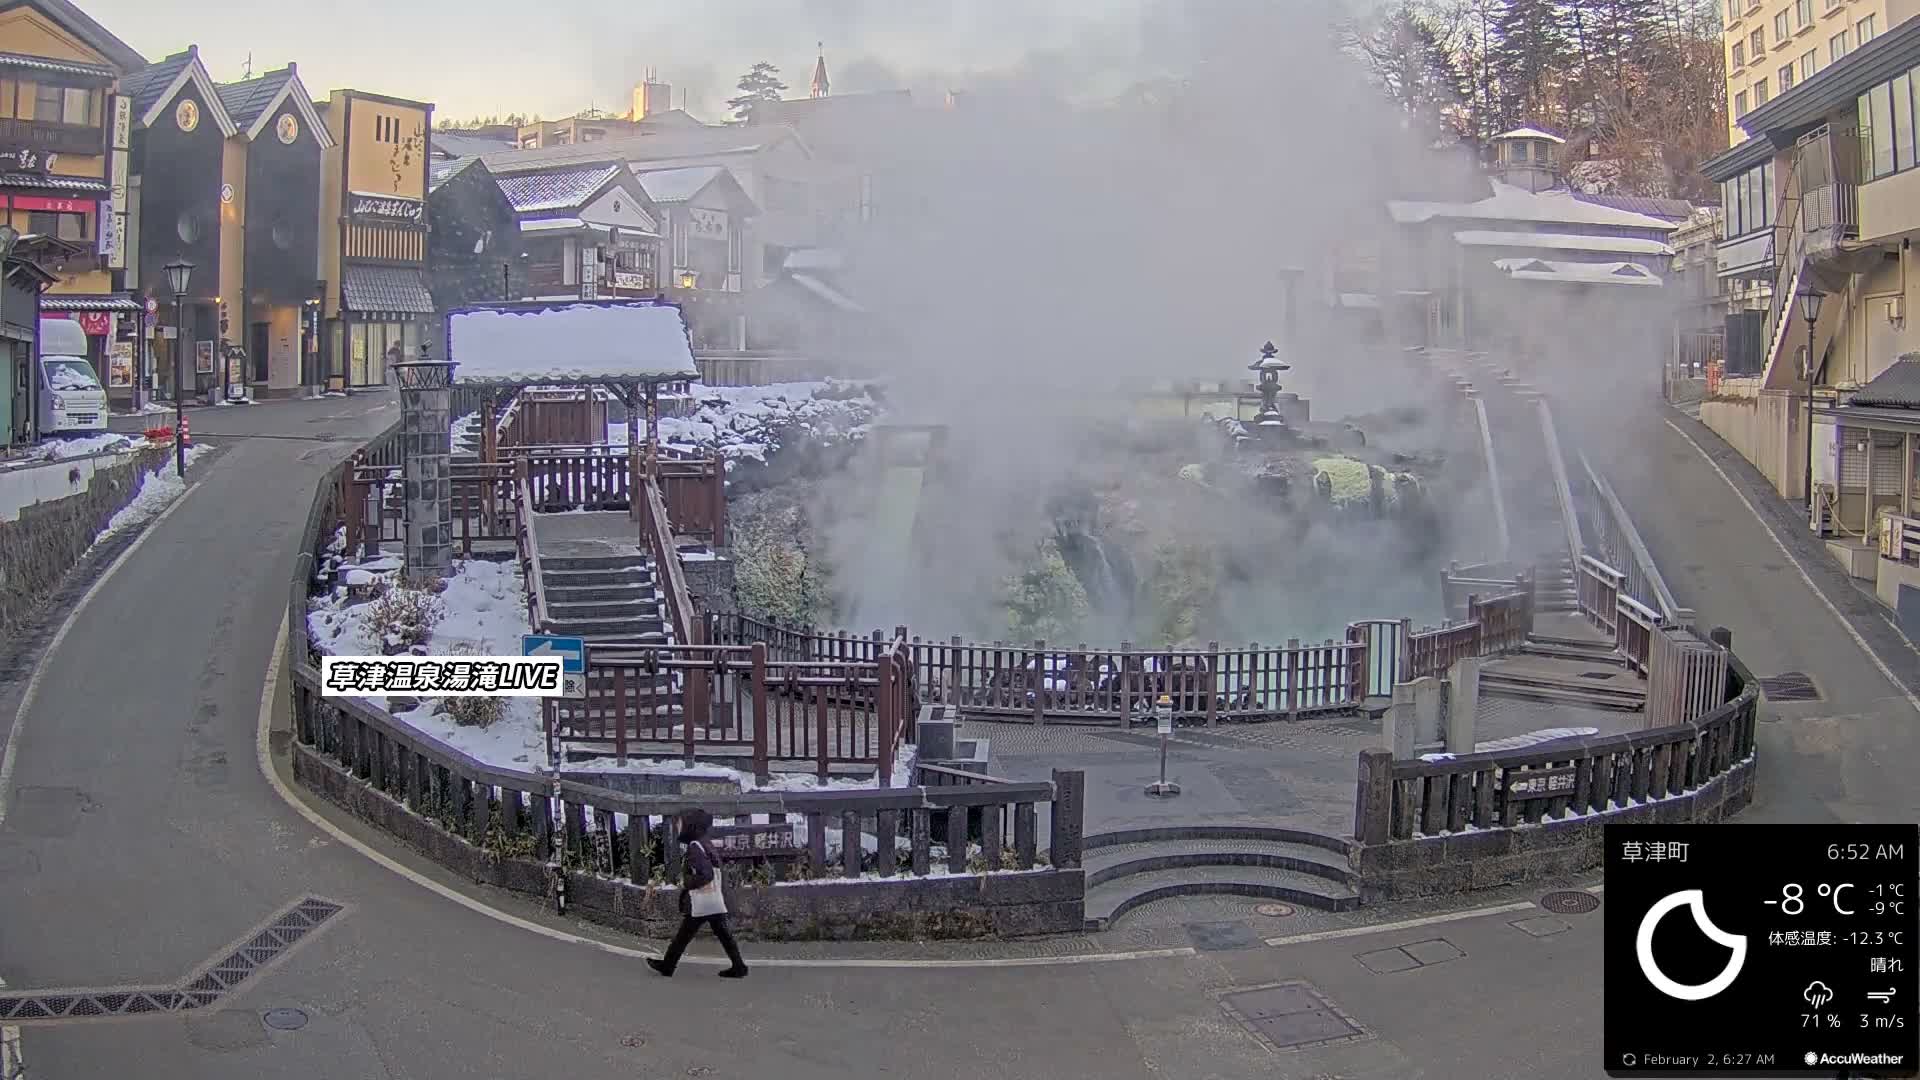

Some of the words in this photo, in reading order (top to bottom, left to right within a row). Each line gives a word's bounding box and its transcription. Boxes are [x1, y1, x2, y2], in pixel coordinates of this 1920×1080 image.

[1548, 773, 1575, 791] 軽井沢
[754, 831, 793, 850] 軽井沢
